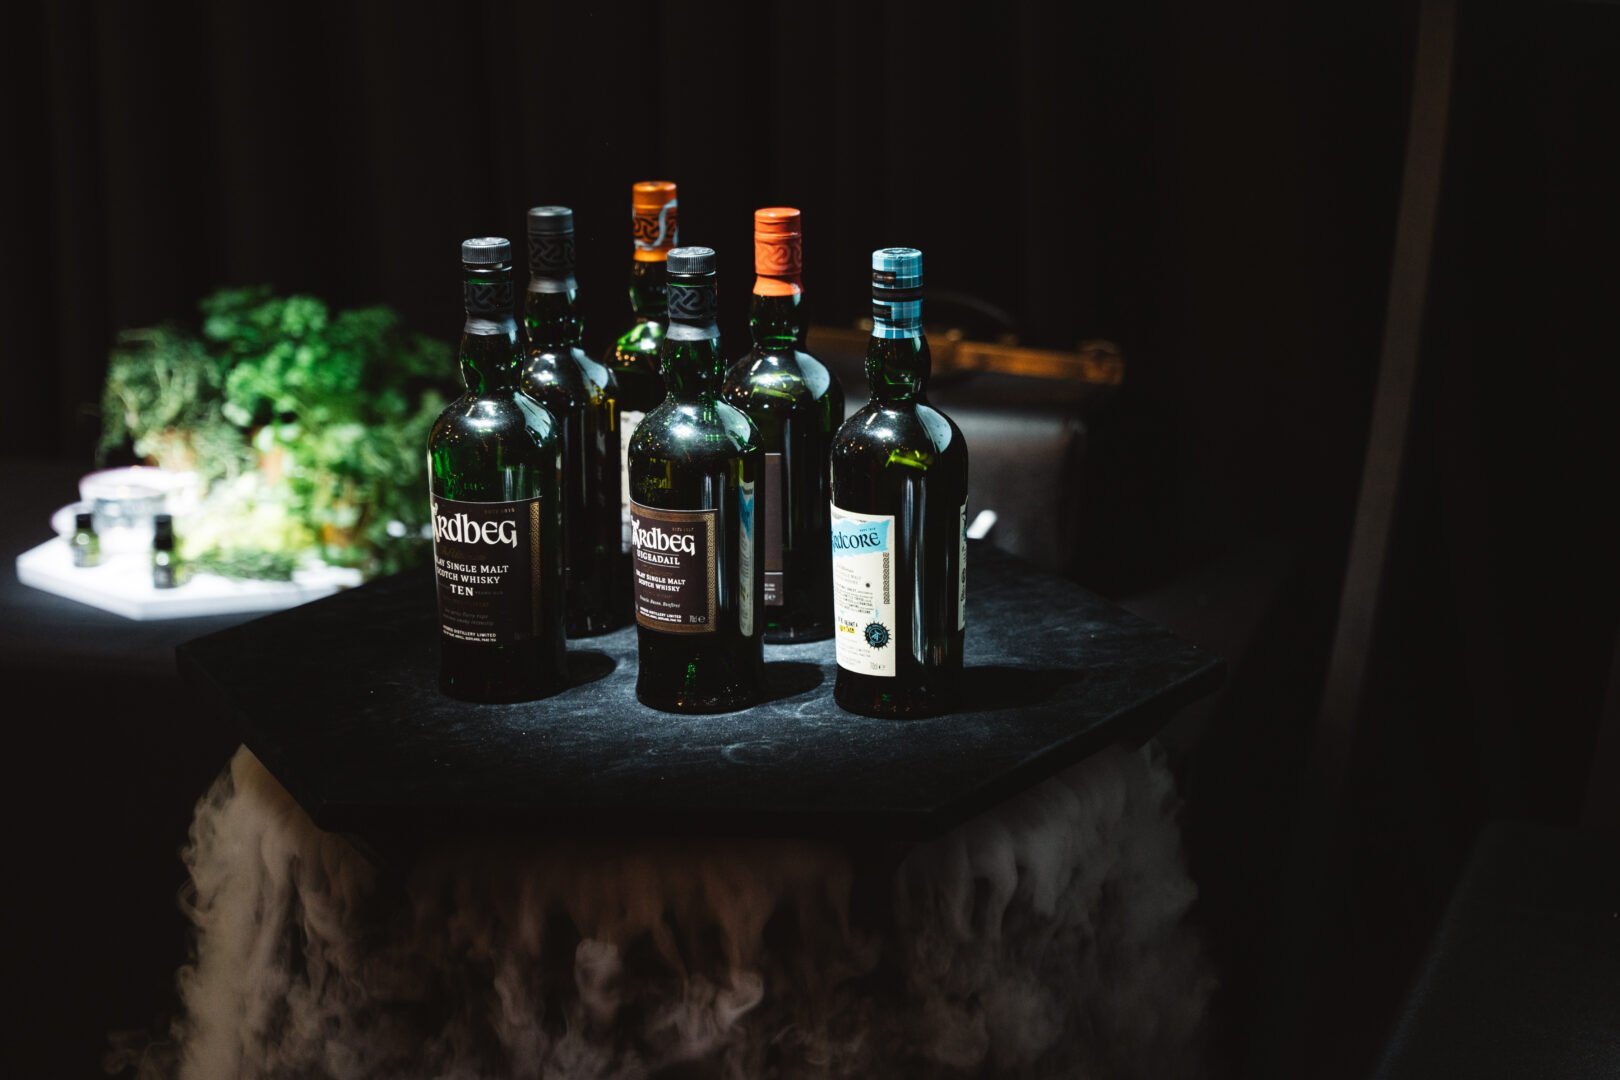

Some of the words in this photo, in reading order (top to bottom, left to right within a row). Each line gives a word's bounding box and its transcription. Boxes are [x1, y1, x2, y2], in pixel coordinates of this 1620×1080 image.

[446, 560, 477, 573] SINGLE
[480, 565, 509, 574] MALT
[460, 575, 500, 584] WHISKY
[646, 574, 667, 584] SINGLE
[450, 583, 474, 597] TEN
[655, 583, 680, 592] WHISKY
